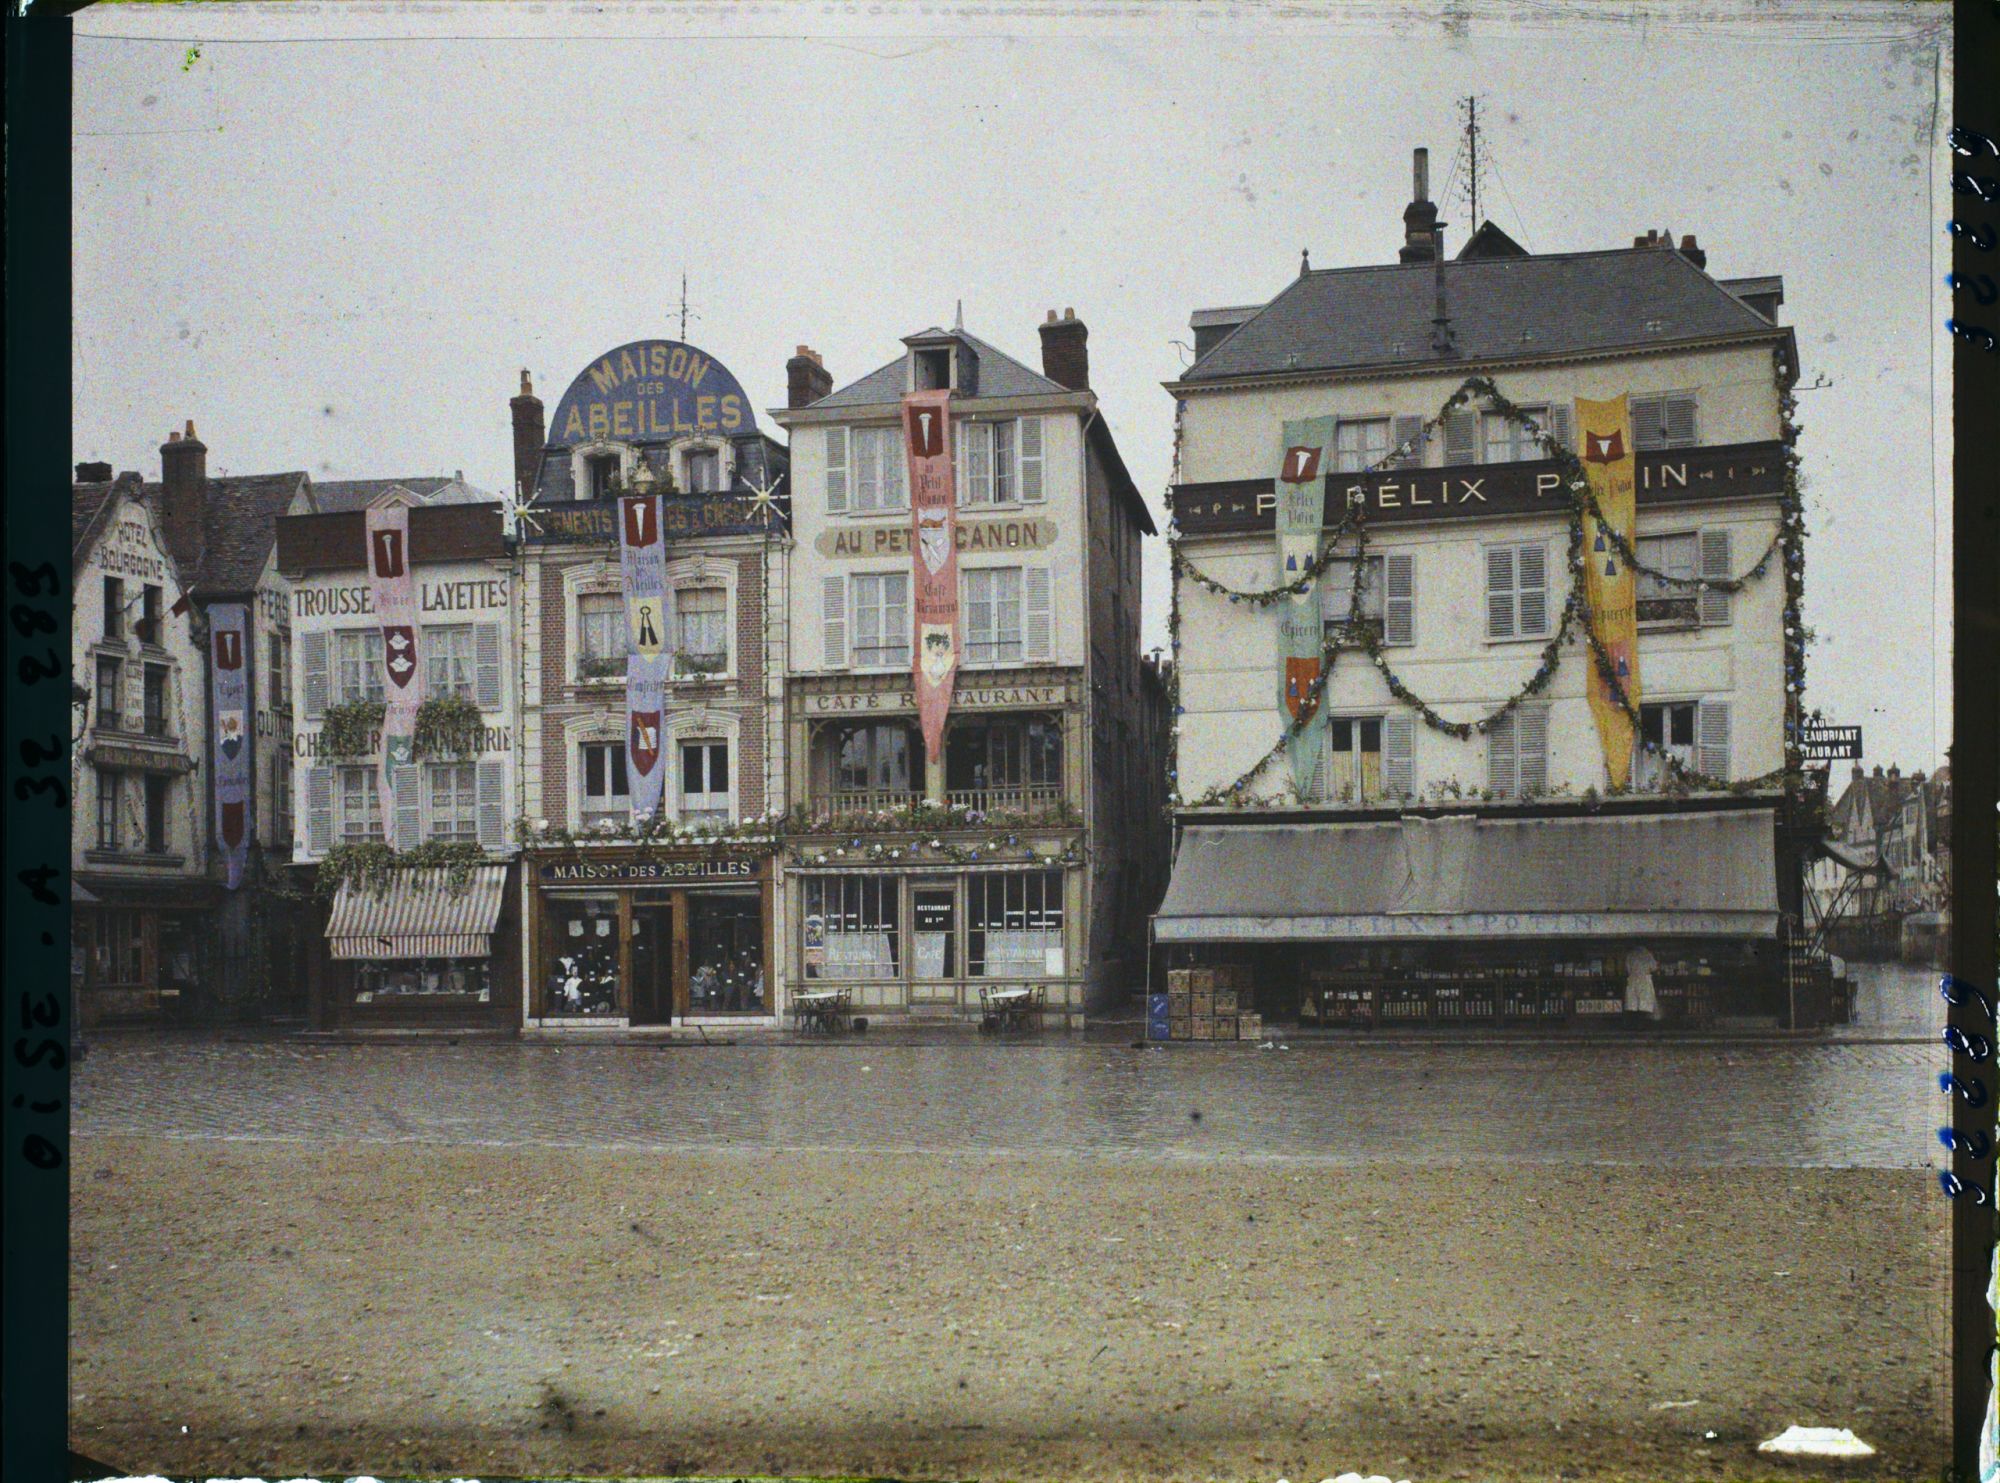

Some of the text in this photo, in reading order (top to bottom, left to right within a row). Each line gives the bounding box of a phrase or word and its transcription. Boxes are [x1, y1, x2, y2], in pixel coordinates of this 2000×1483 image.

[590, 345, 710, 395] MAISON
[637, 381, 664, 395] DES
[563, 394, 742, 440] ABEILLES
[1536, 463, 1688, 497] PIN
[834, 522, 1038, 554] AU PET CANON
[100, 545, 164, 580] BOURGOGNE
[294, 586, 376, 617] TROUSSE
[422, 579, 508, 612] LAYETTES
[816, 688, 1054, 711] CAFÉ RTAURANT
[1802, 745, 1852, 758] TAURANT
[1804, 729, 1857, 742] EAUBRIANT
[553, 861, 750, 879] MAISON DES ABEILLES
